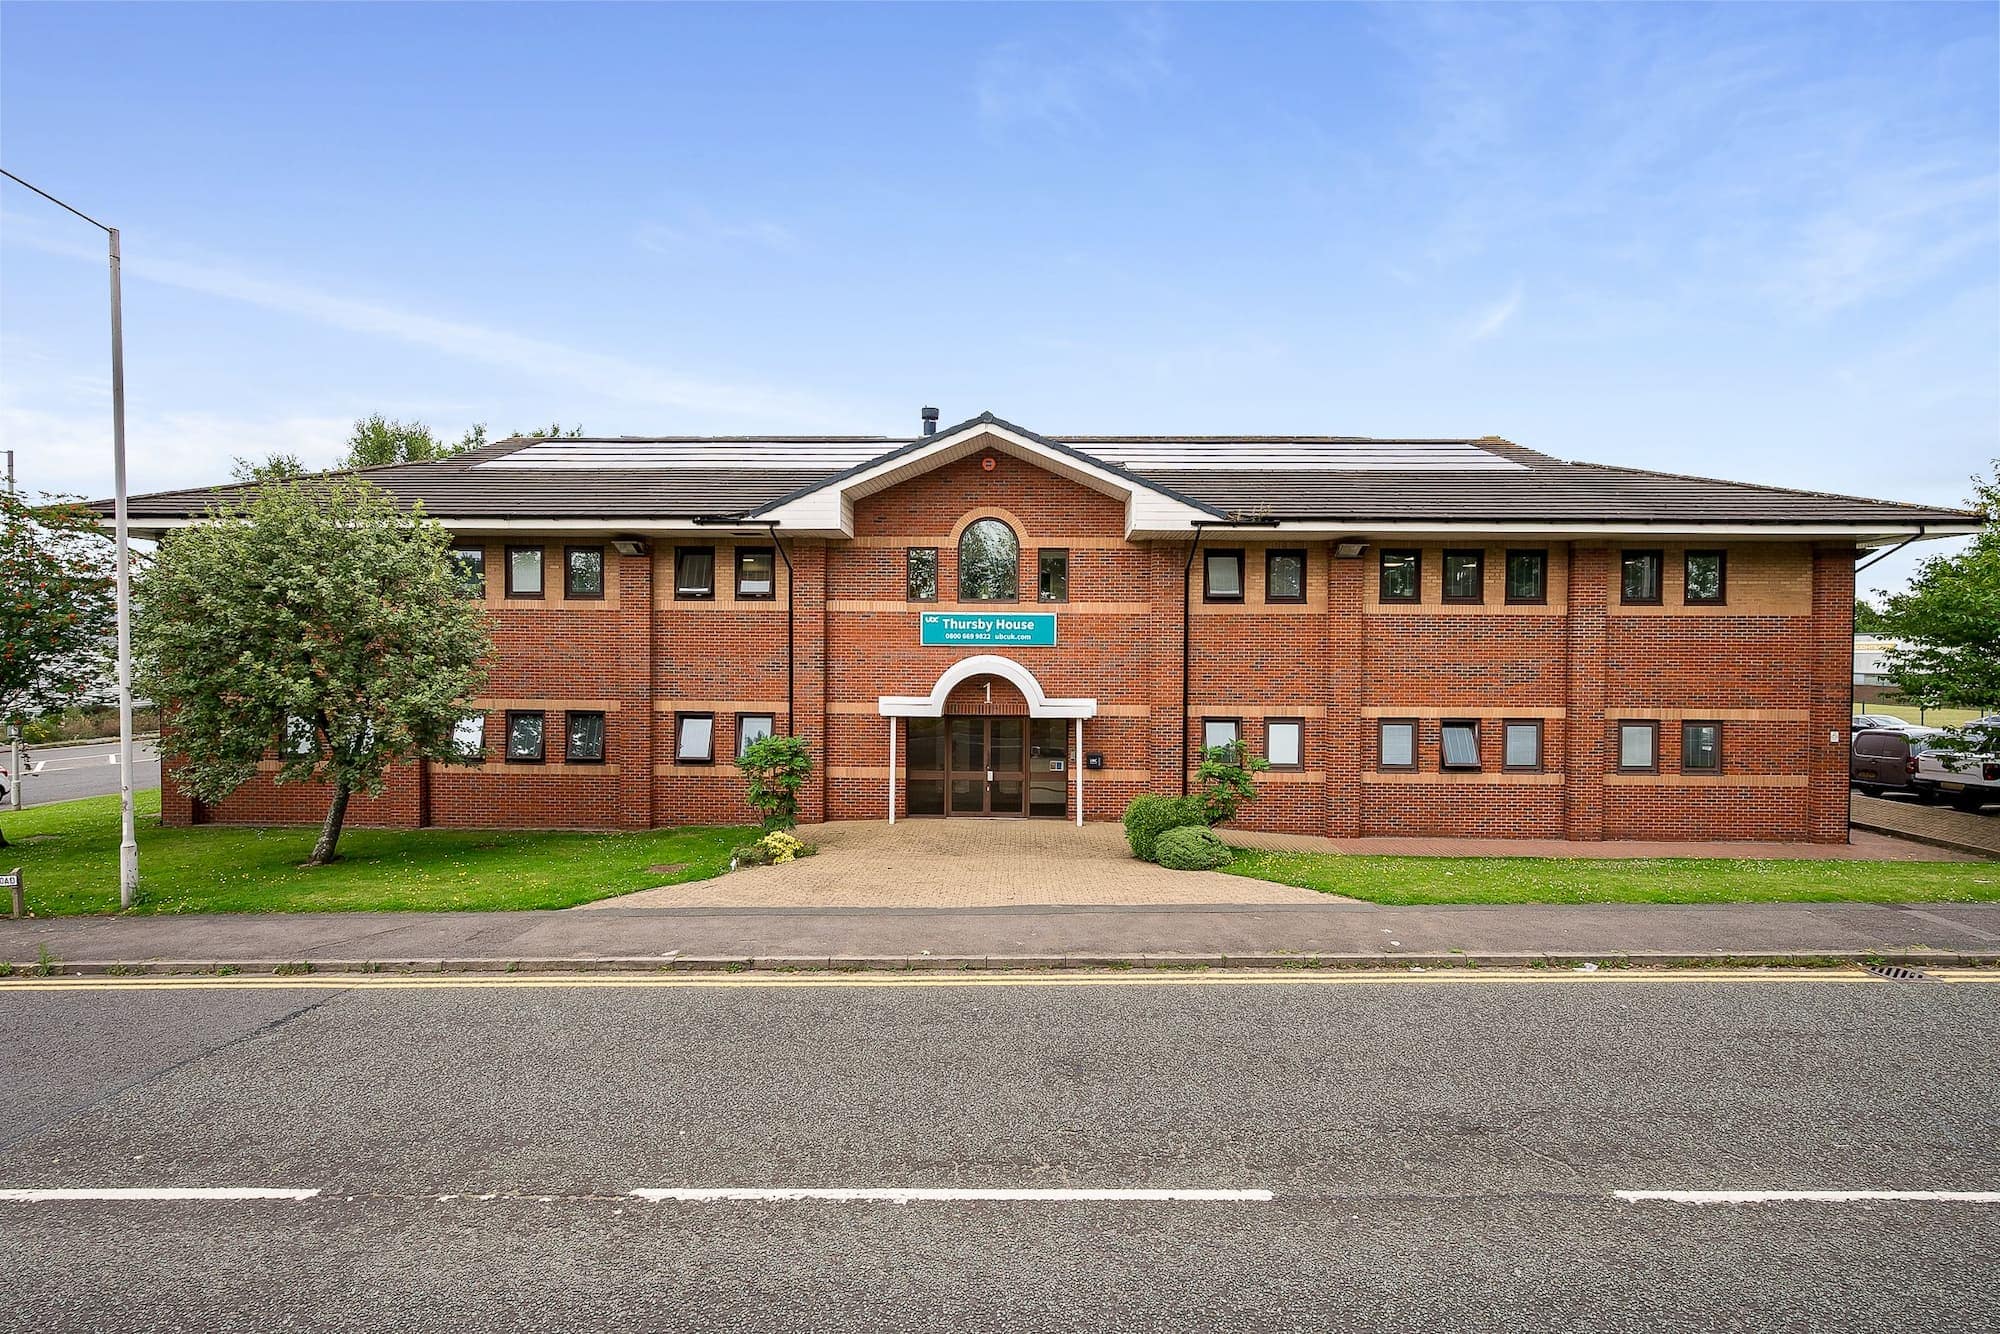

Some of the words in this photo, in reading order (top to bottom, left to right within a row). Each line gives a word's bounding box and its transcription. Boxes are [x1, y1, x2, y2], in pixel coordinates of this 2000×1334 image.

[942, 618, 993, 632] Thursby
[996, 619, 1035, 630] House
[995, 633, 1031, 641] ubcuk.com
[983, 682, 992, 704] 1
